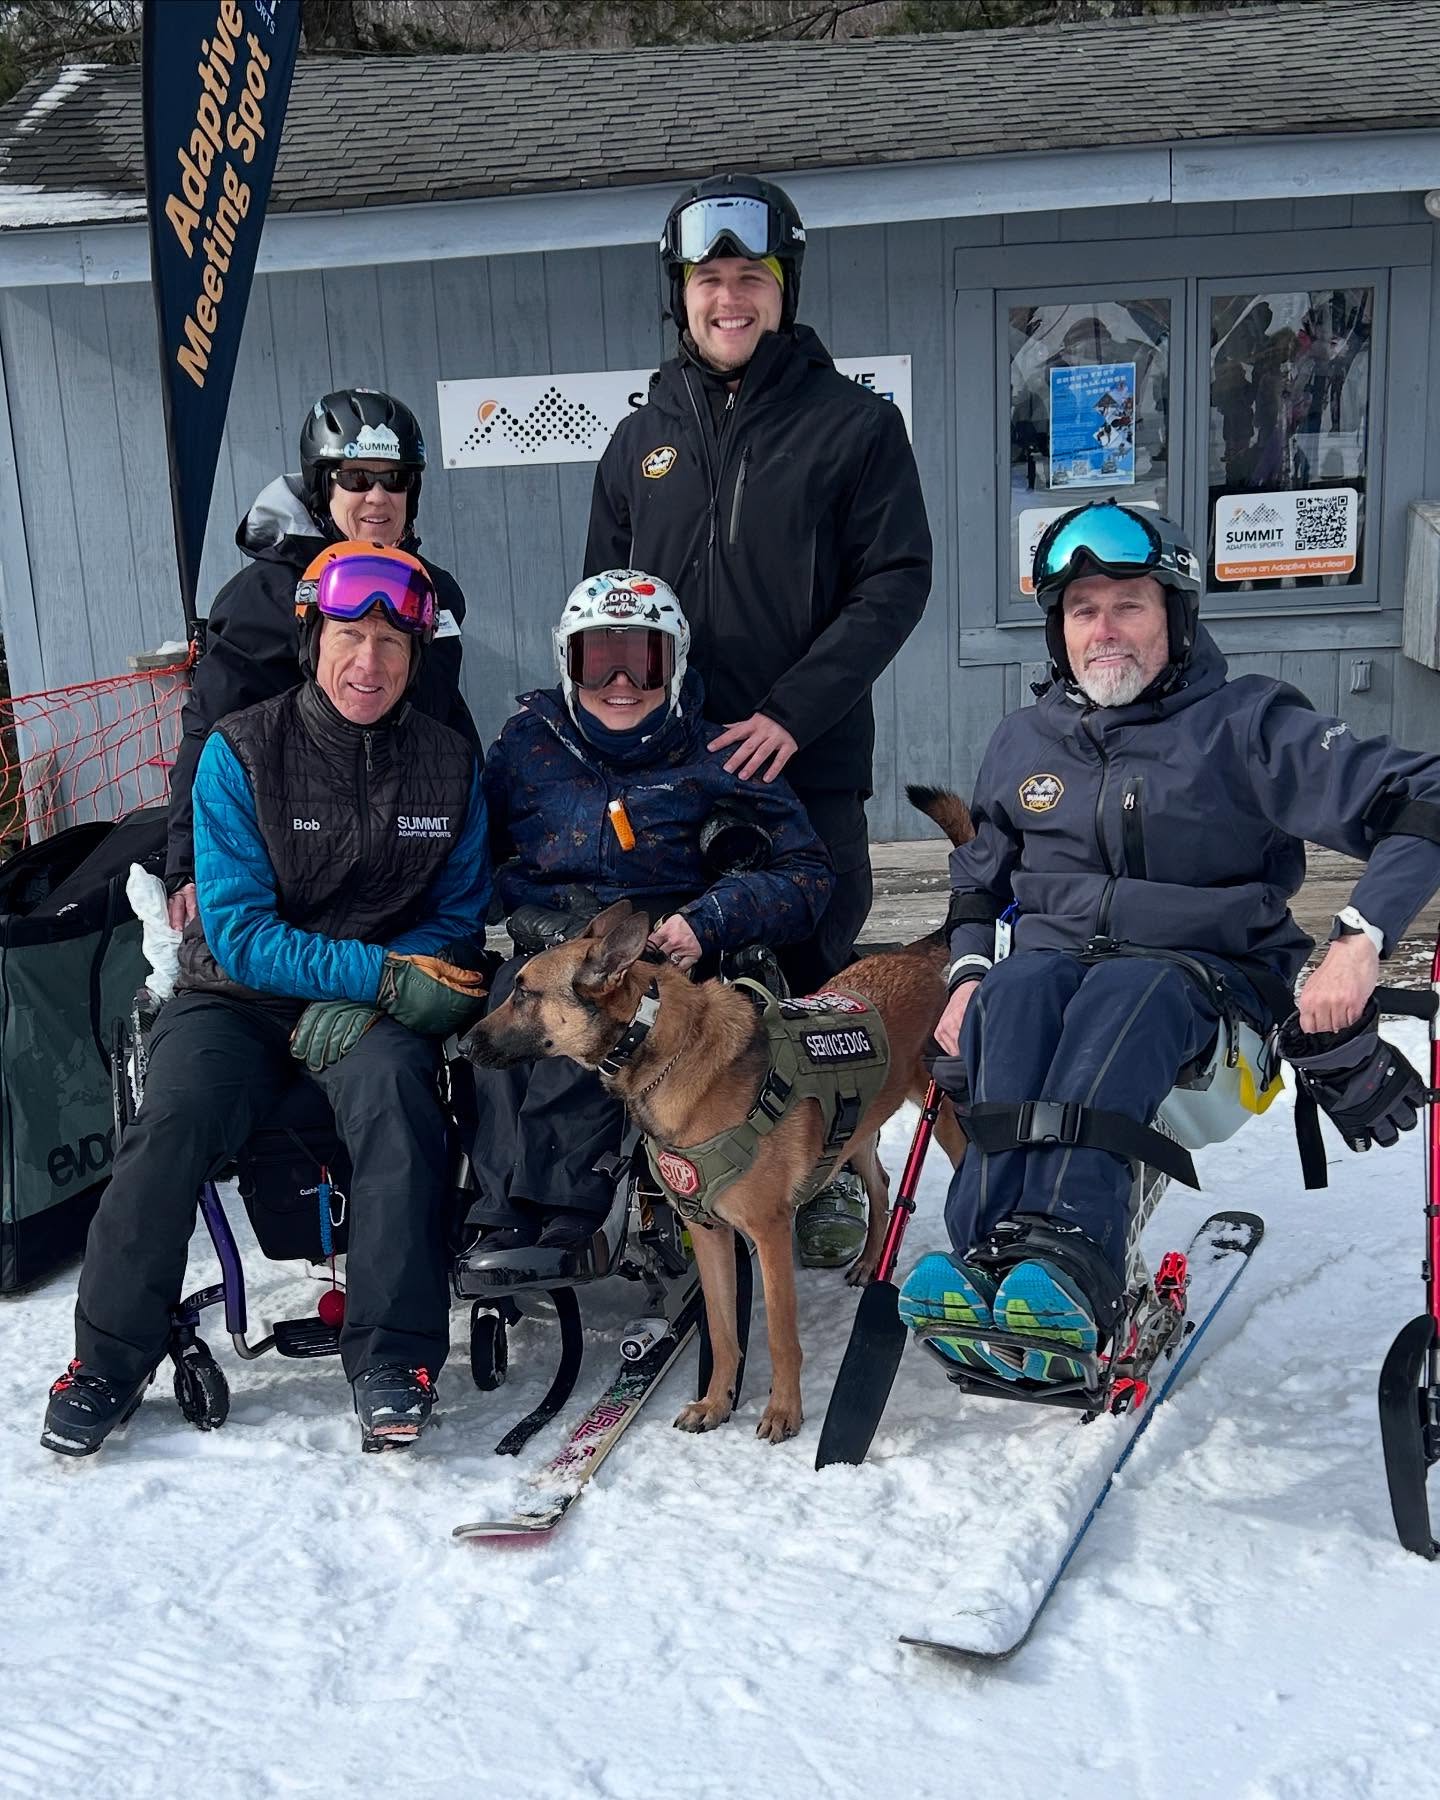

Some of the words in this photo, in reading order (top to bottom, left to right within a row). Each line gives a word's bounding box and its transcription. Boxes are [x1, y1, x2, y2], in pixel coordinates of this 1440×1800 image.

[165, 0, 244, 258] Adaptive
[176, 161, 251, 389] Meeting
[226, 31, 271, 164] Spot
[359, 442, 399, 452] SUMMIT
[1226, 528, 1284, 544] SUMMIT
[1226, 543, 1257, 551] ADAPTIVE
[1259, 541, 1284, 549] SPORTS
[1224, 565, 1257, 575] Become
[1258, 565, 1271, 573] an
[1271, 562, 1307, 572] Adaptive
[293, 818, 321, 831] Bob
[397, 815, 450, 830] SUMMIT
[398, 830, 428, 838] ADAPTIVE
[806, 1032, 849, 1057] SERVICE
[844, 1030, 871, 1054] DOG
[660, 1162, 692, 1188] STOP
